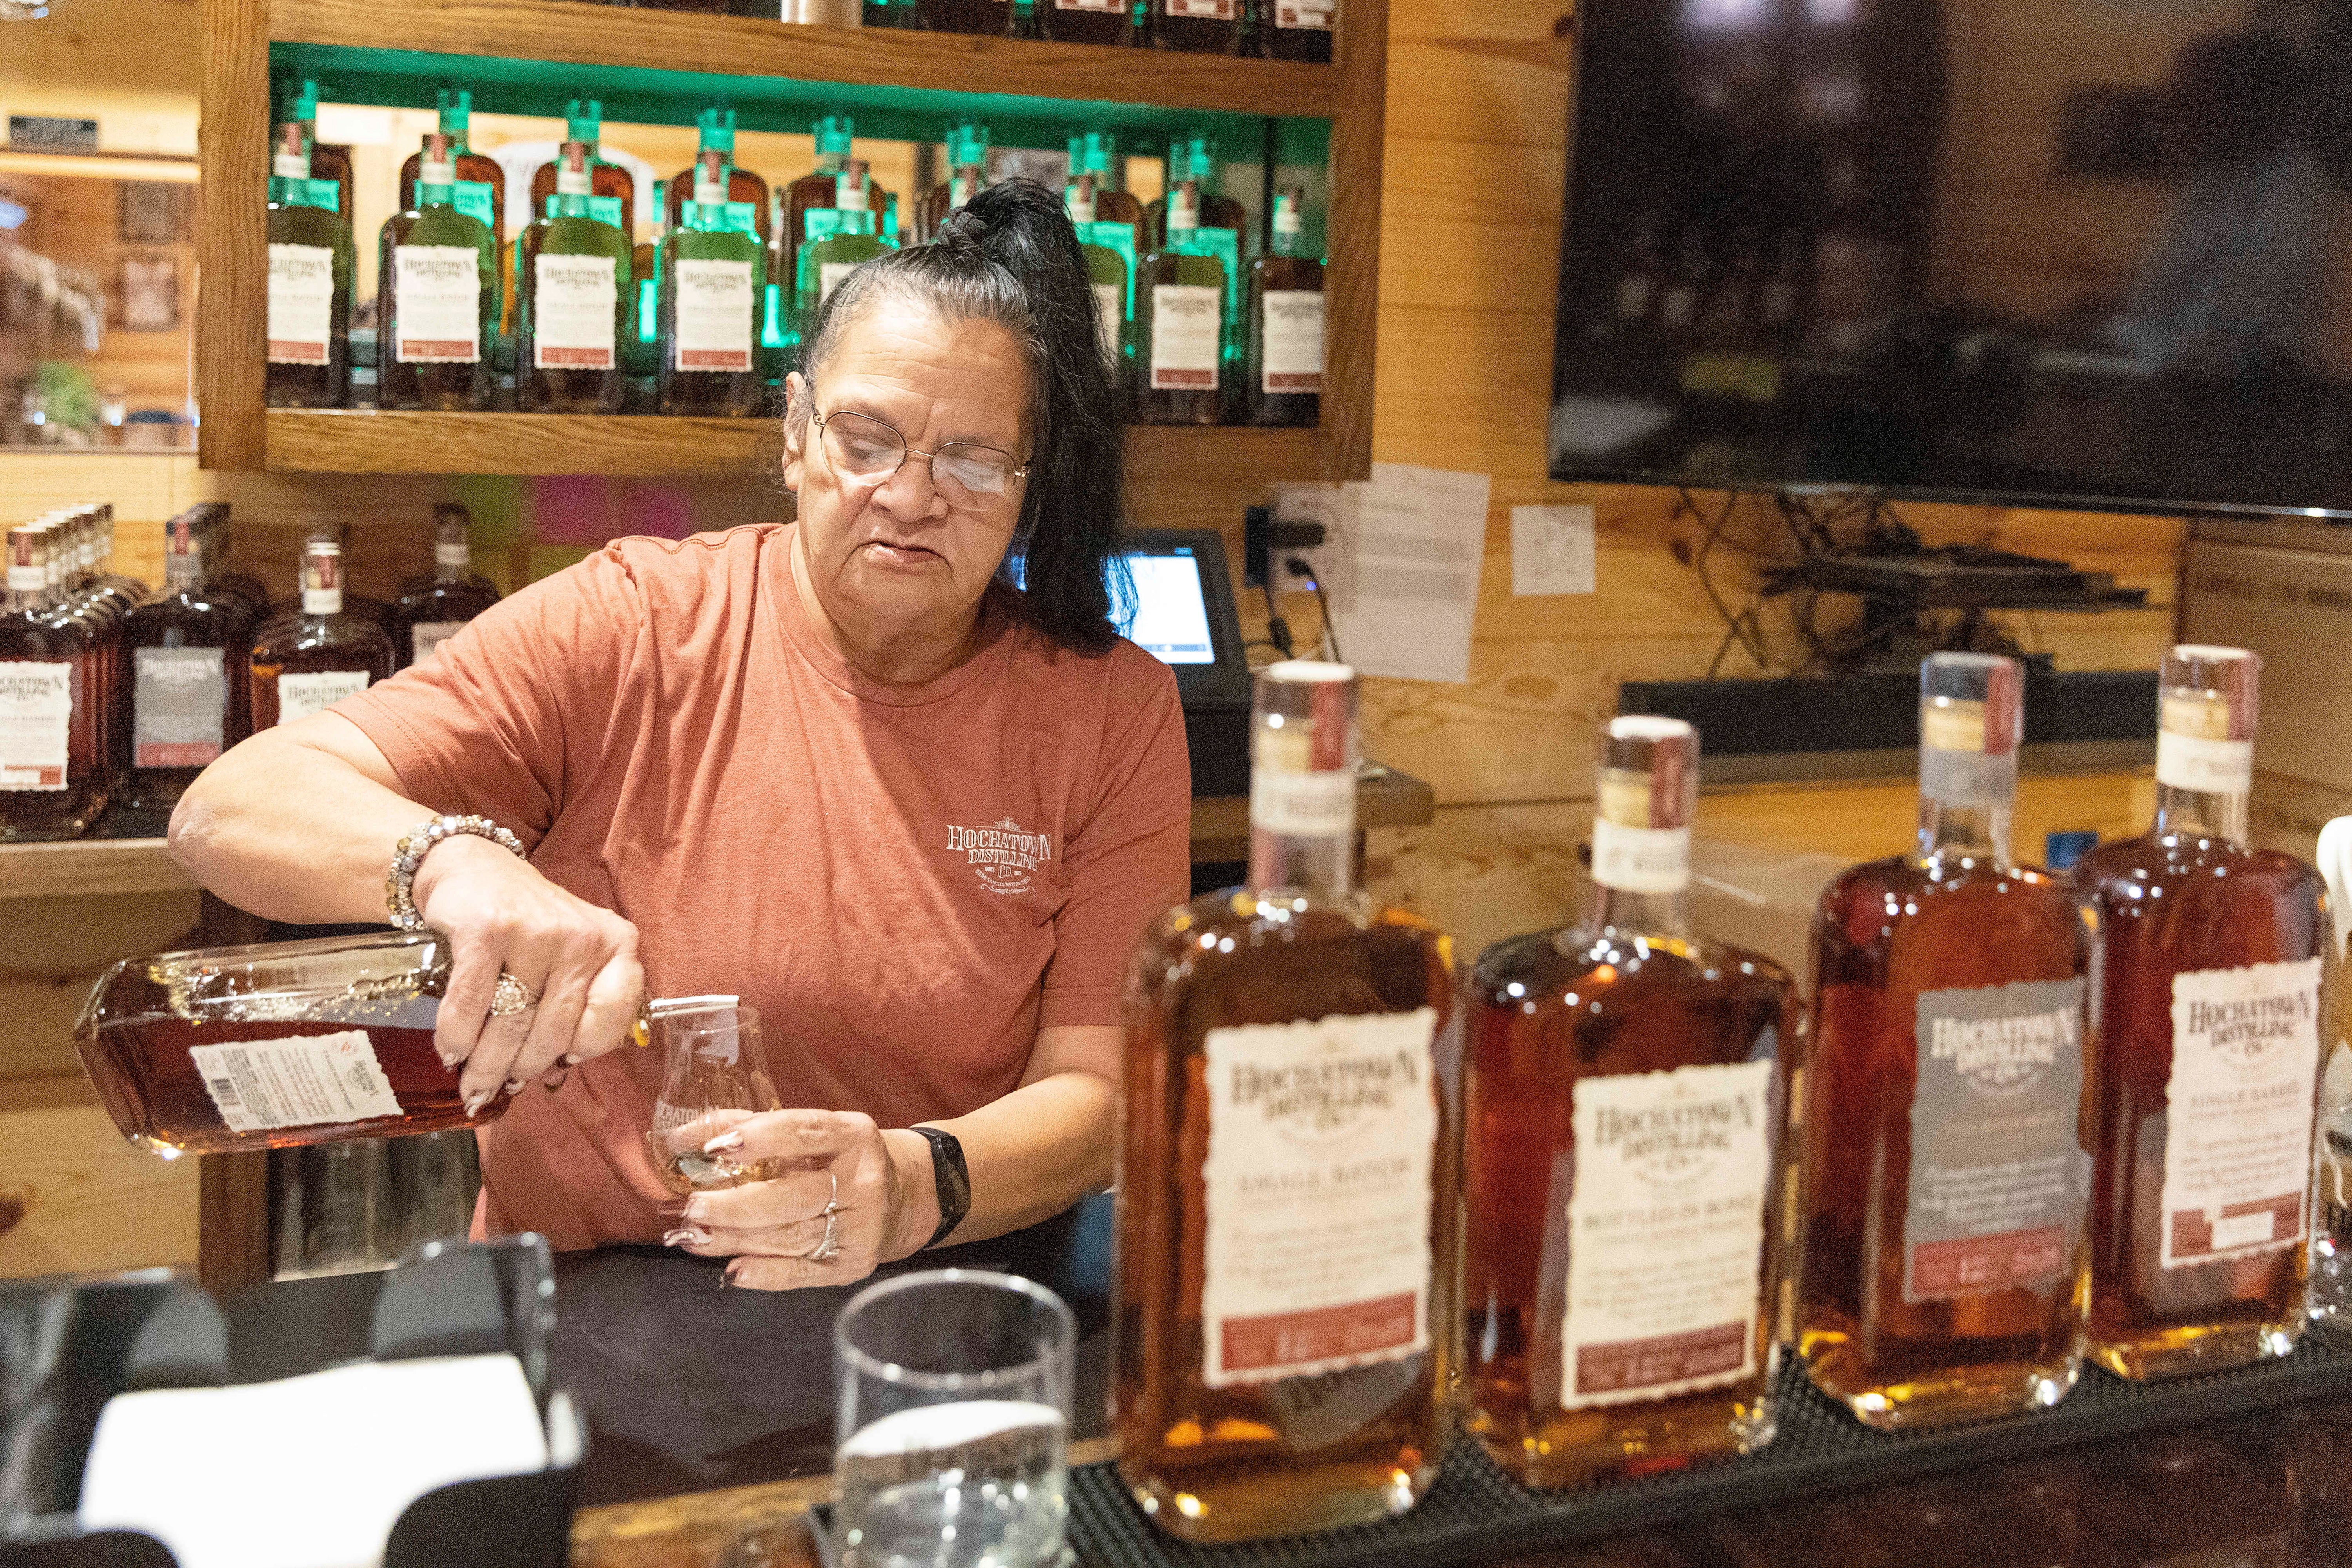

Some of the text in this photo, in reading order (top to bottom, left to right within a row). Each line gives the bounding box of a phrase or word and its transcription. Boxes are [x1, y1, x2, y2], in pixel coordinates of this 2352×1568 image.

[946, 824, 1051, 860] HOCHATOWN
[967, 849, 1039, 871] DISTILLING
[1931, 1007, 2076, 1057] HOCHATOWN
[2188, 991, 2310, 1035] HOCHATOWN
[1231, 1049, 1417, 1105] HOCHATOWN
[1595, 1094, 1754, 1146] HOCHATOWN
